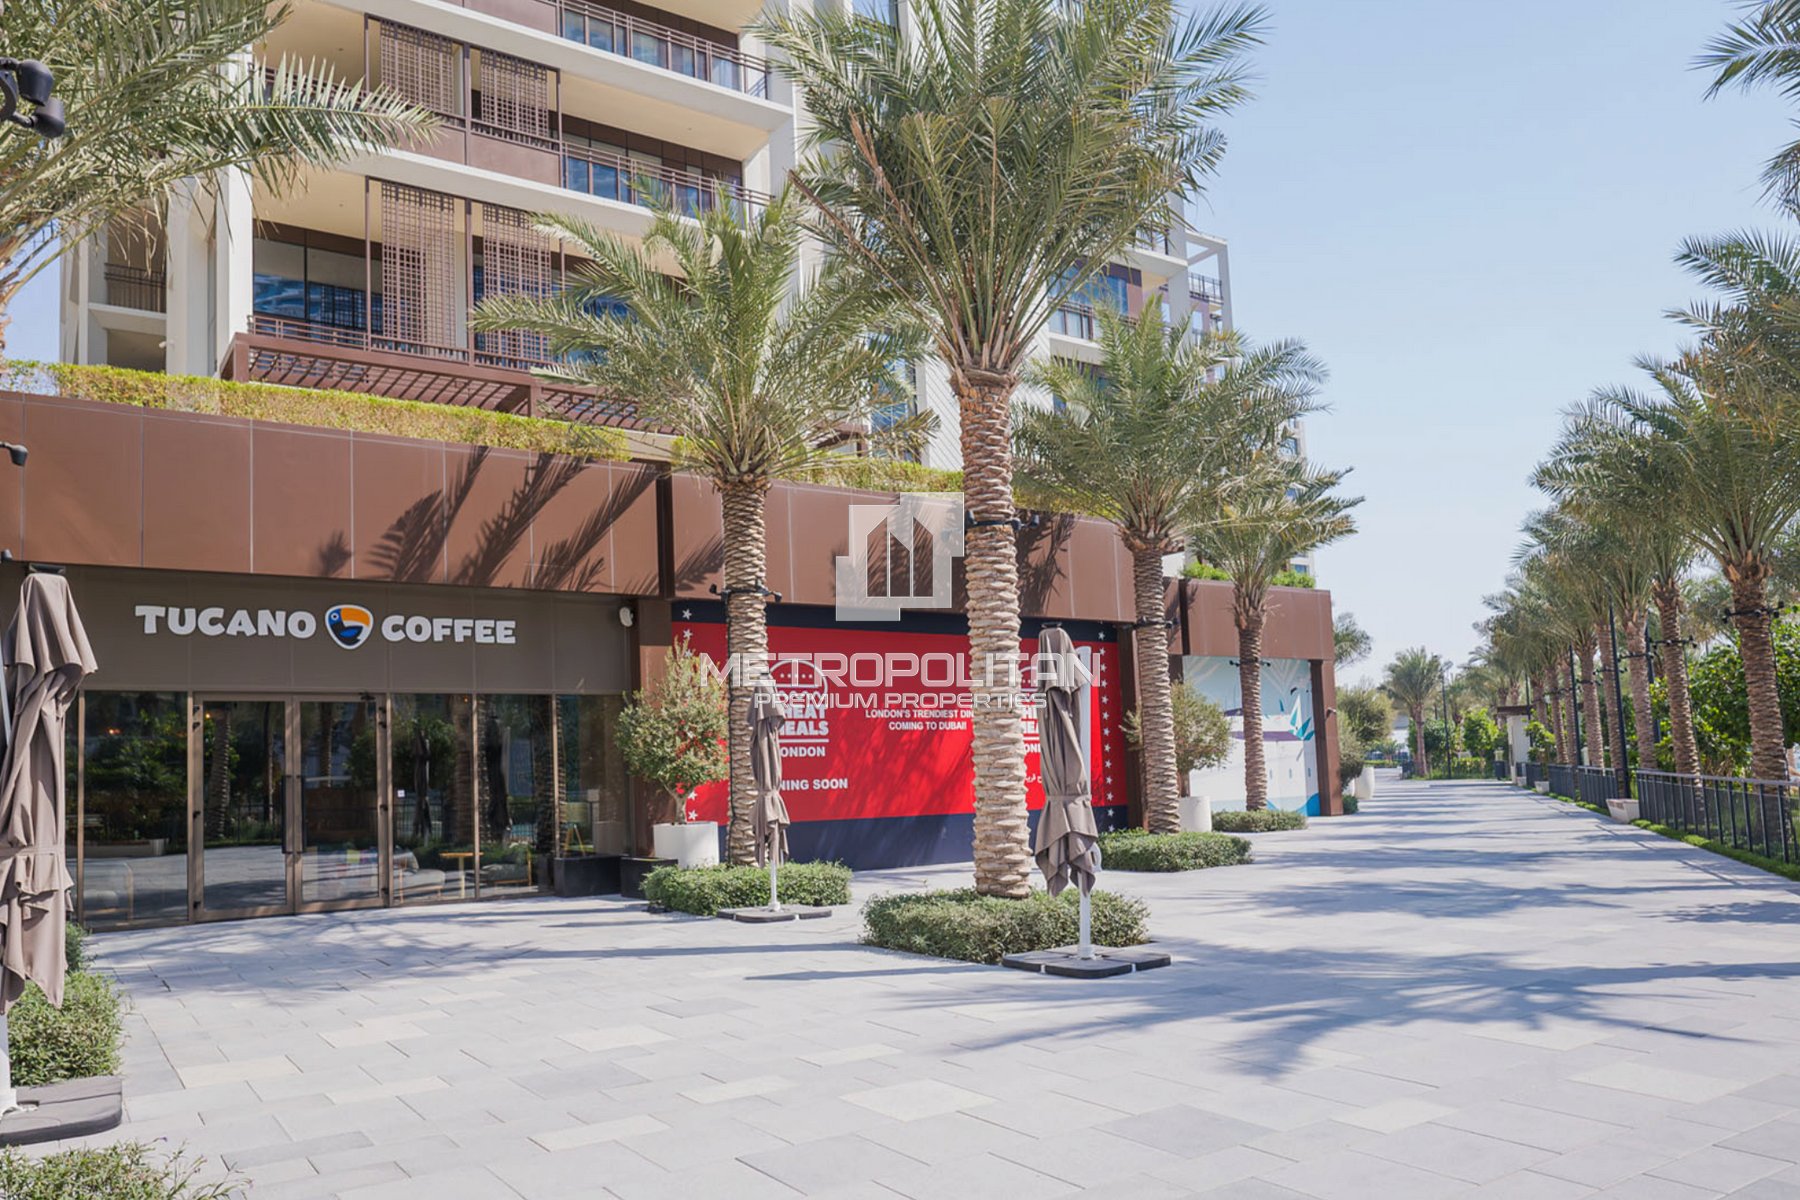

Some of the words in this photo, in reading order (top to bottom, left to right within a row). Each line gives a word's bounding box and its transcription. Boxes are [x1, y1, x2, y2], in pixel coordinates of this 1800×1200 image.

[135, 605, 317, 638] TUCANO
[381, 615, 517, 644] COFFEE
[866, 710, 911, 719] LONDON'S
[914, 709, 958, 718] TRENDIEST
[779, 720, 829, 736] EALS
[888, 721, 924, 731] COMING
[926, 721, 937, 730] TO
[780, 746, 826, 757] ONDON
[812, 777, 848, 790] SOON
